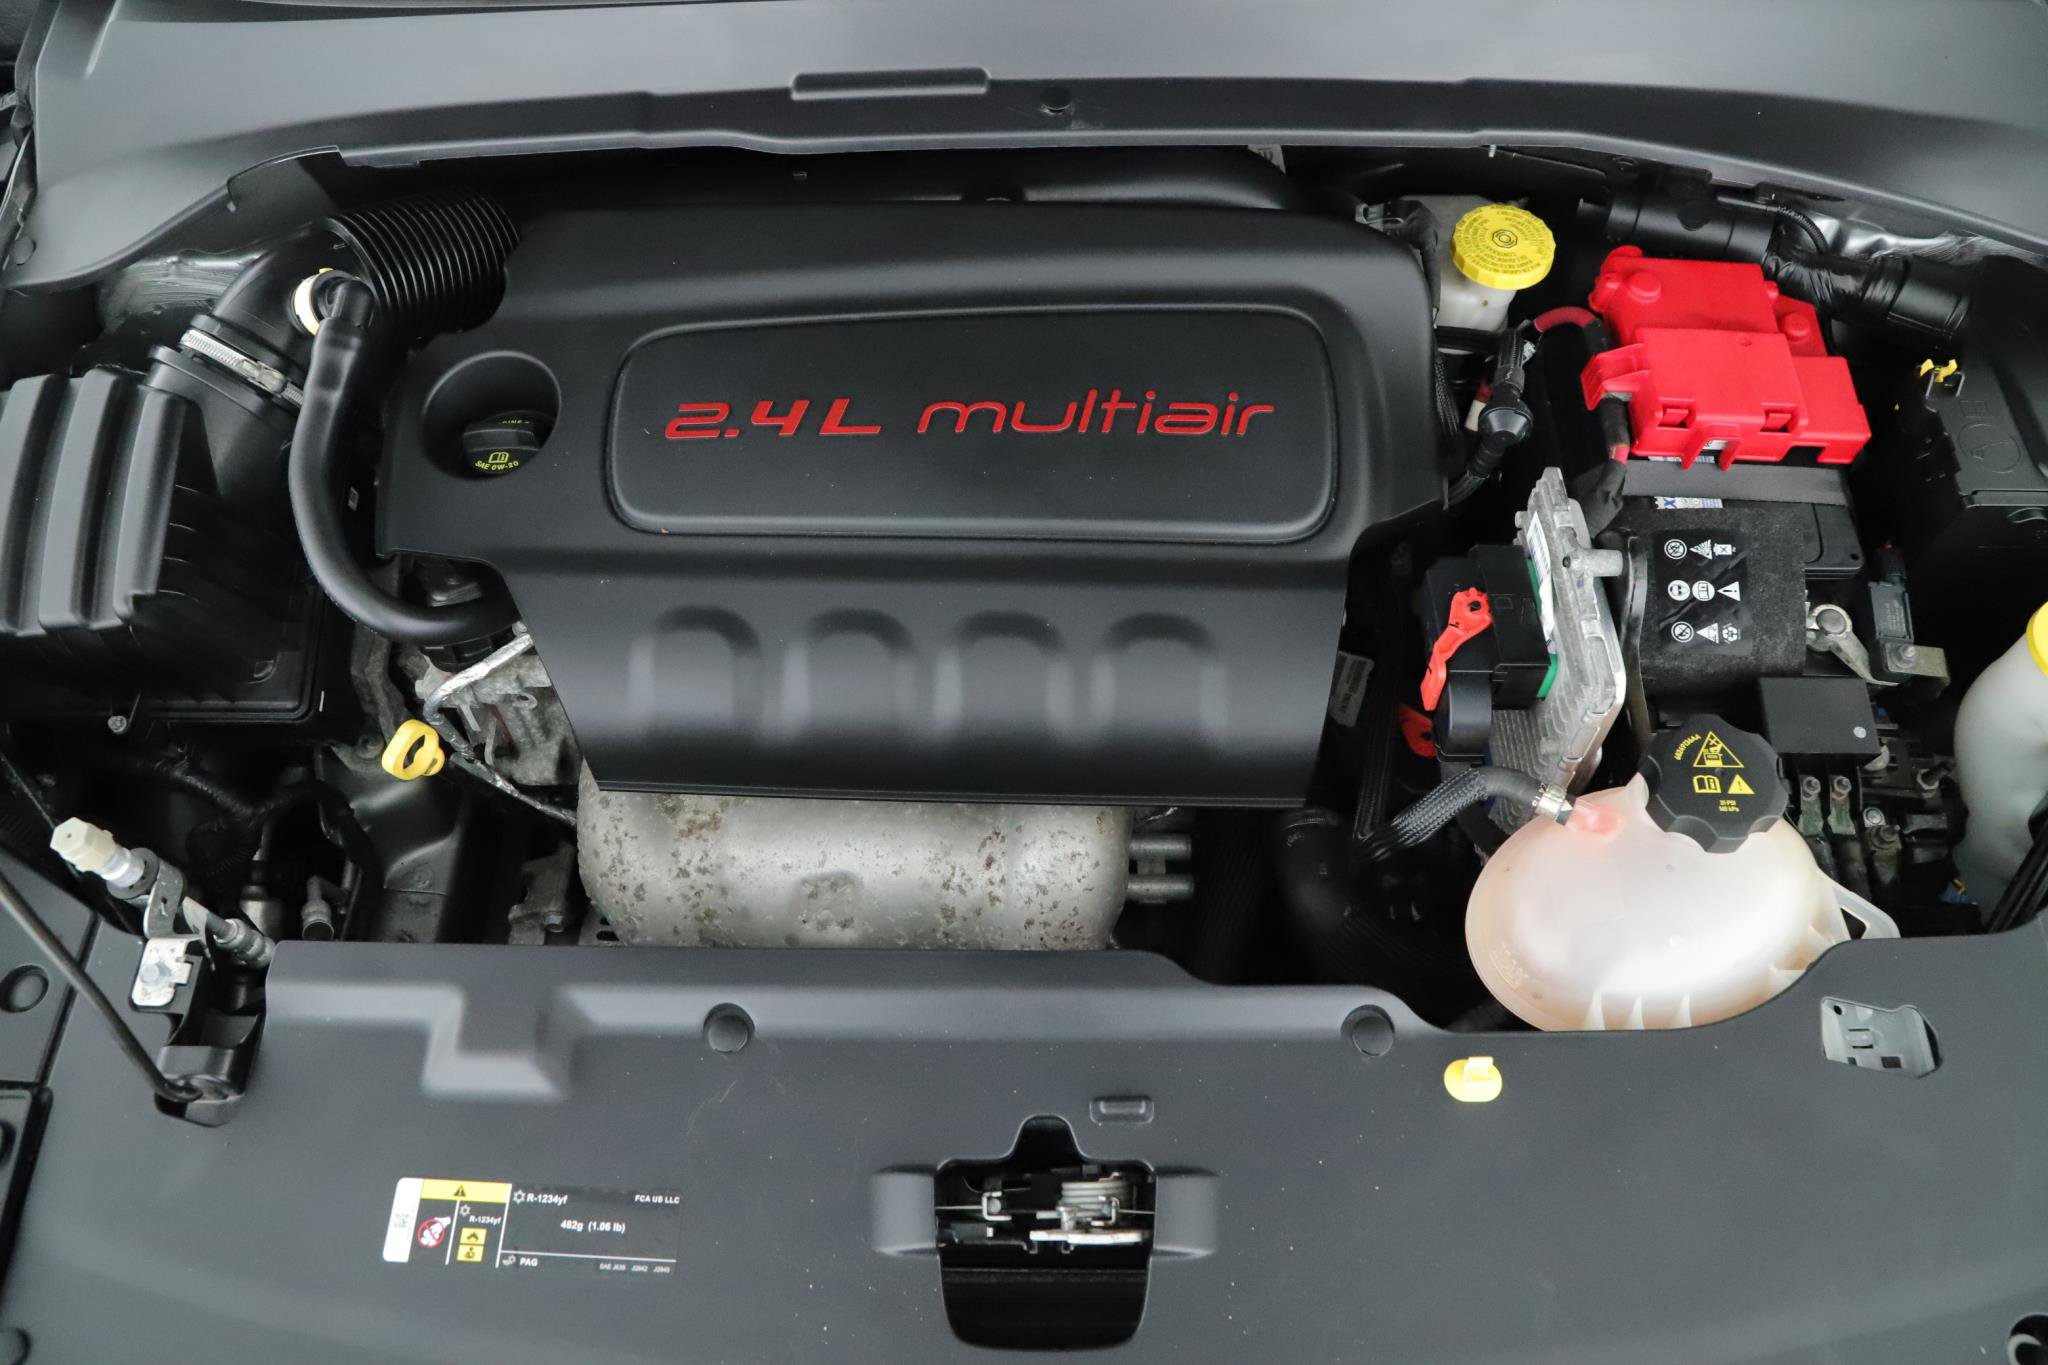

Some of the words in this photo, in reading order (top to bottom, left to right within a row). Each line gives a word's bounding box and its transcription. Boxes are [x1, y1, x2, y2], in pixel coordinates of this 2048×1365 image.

[916, 388, 1275, 436] multiair
[475, 460, 490, 470] SAE
[491, 460, 519, 471] 0W-20
[526, 1193, 568, 1206] R-1234yf
[652, 1195, 663, 1203] US
[664, 1196, 680, 1204] LLC
[469, 1215, 502, 1226] R-1234yf
[560, 1220, 584, 1232] 482g
[588, 1221, 611, 1232] (1.06
[613, 1222, 626, 1234] lb)
[520, 1258, 538, 1267] PAG
